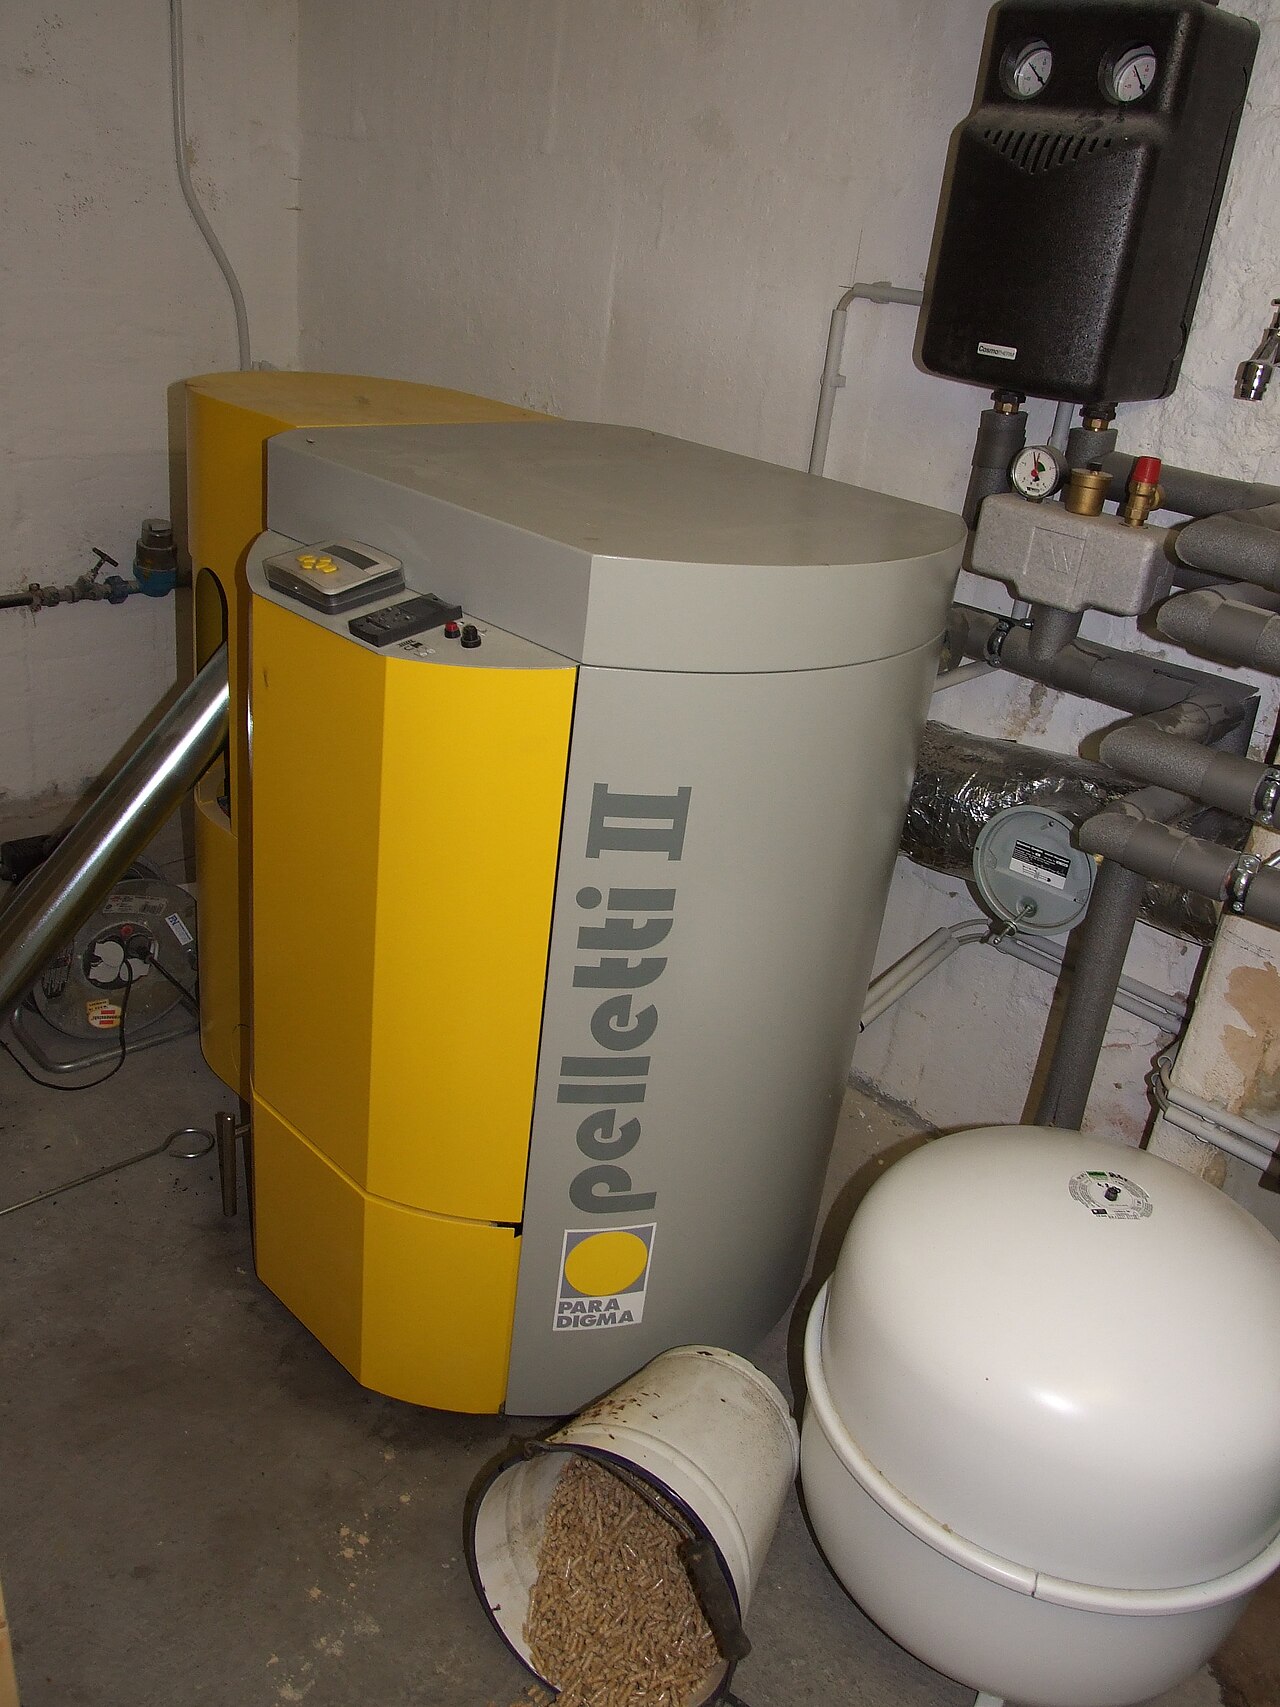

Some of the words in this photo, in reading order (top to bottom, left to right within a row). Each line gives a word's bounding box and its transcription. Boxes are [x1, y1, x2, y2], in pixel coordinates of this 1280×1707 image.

[979, 345, 1015, 358] Cosmo
[586, 783, 692, 861] II
[557, 886, 676, 1213] pelletti
[558, 1298, 620, 1314] PARA
[557, 1310, 634, 1328] DIGMA
